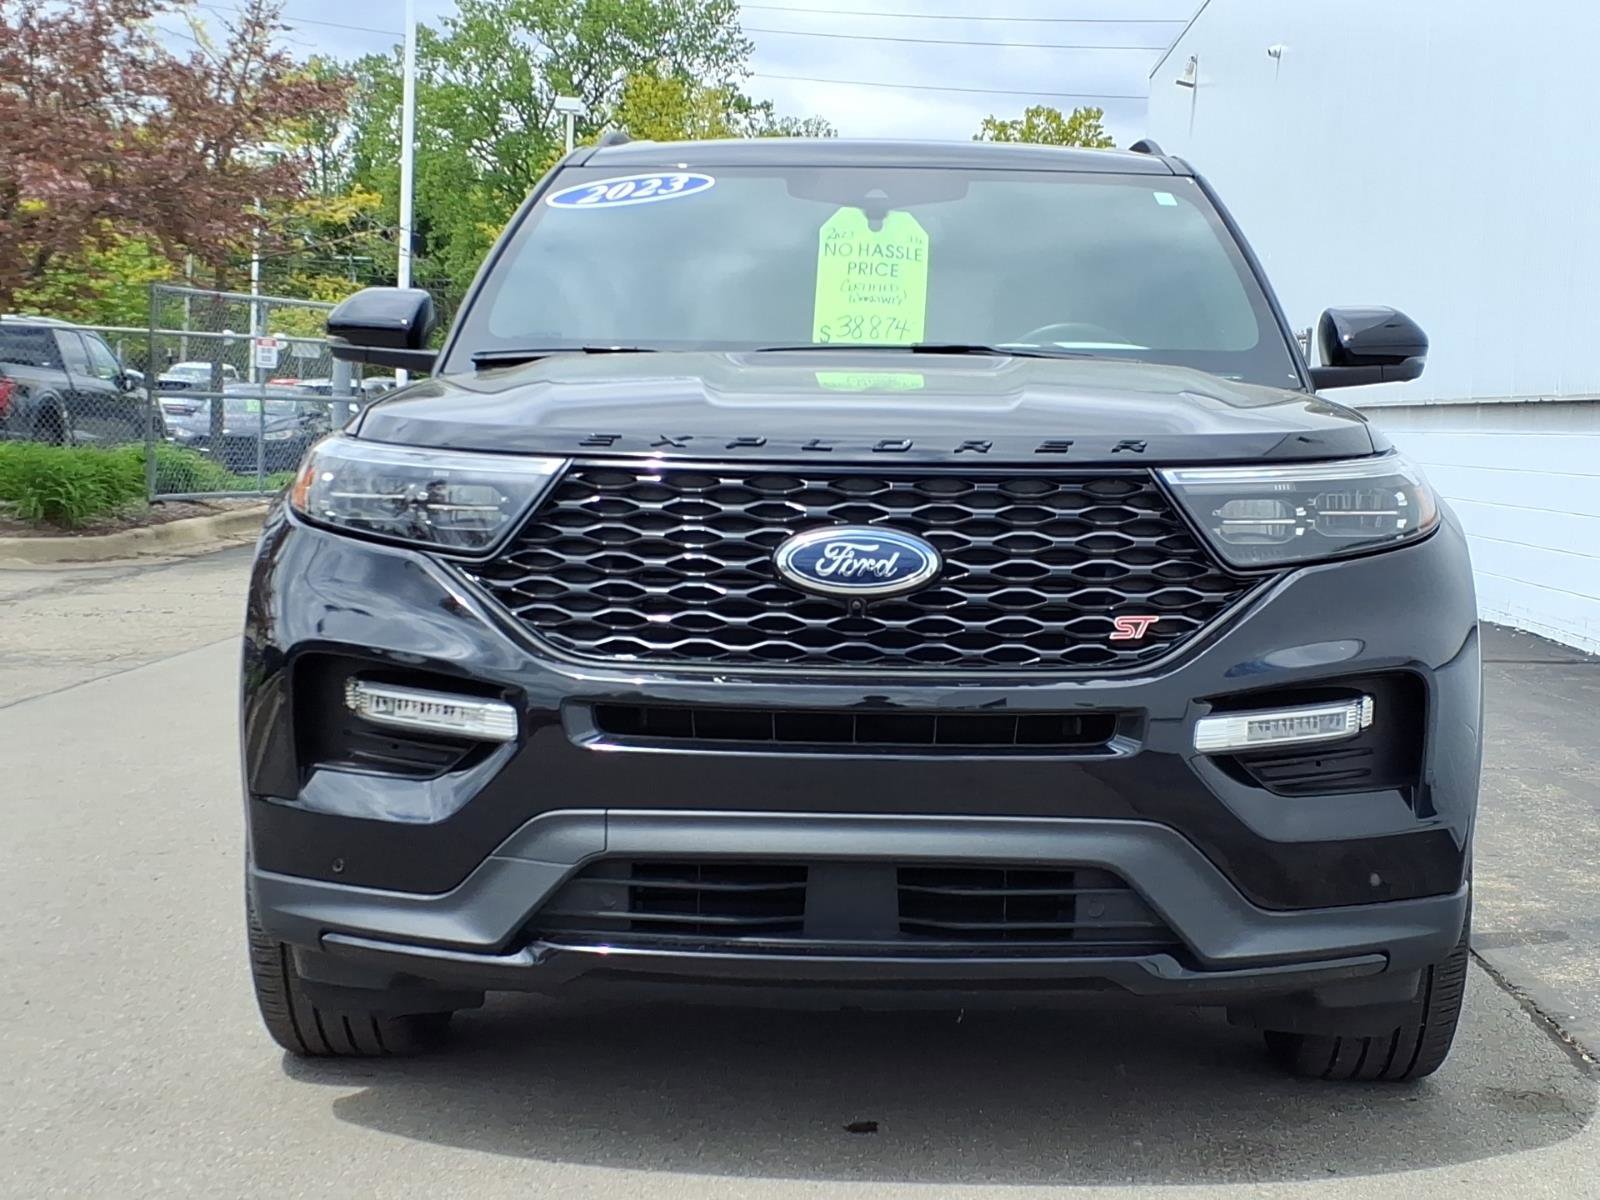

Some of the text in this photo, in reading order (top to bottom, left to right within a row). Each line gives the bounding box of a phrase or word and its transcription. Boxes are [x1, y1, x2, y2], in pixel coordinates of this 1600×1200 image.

[576, 175, 690, 204] 2023
[824, 243, 923, 262] NO HASSLE
[847, 262, 899, 277] PRICE
[835, 314, 911, 341] 38874
[578, 432, 1148, 454] EXPLORER
[815, 541, 900, 577] Ford
[1109, 615, 1160, 640] ST
